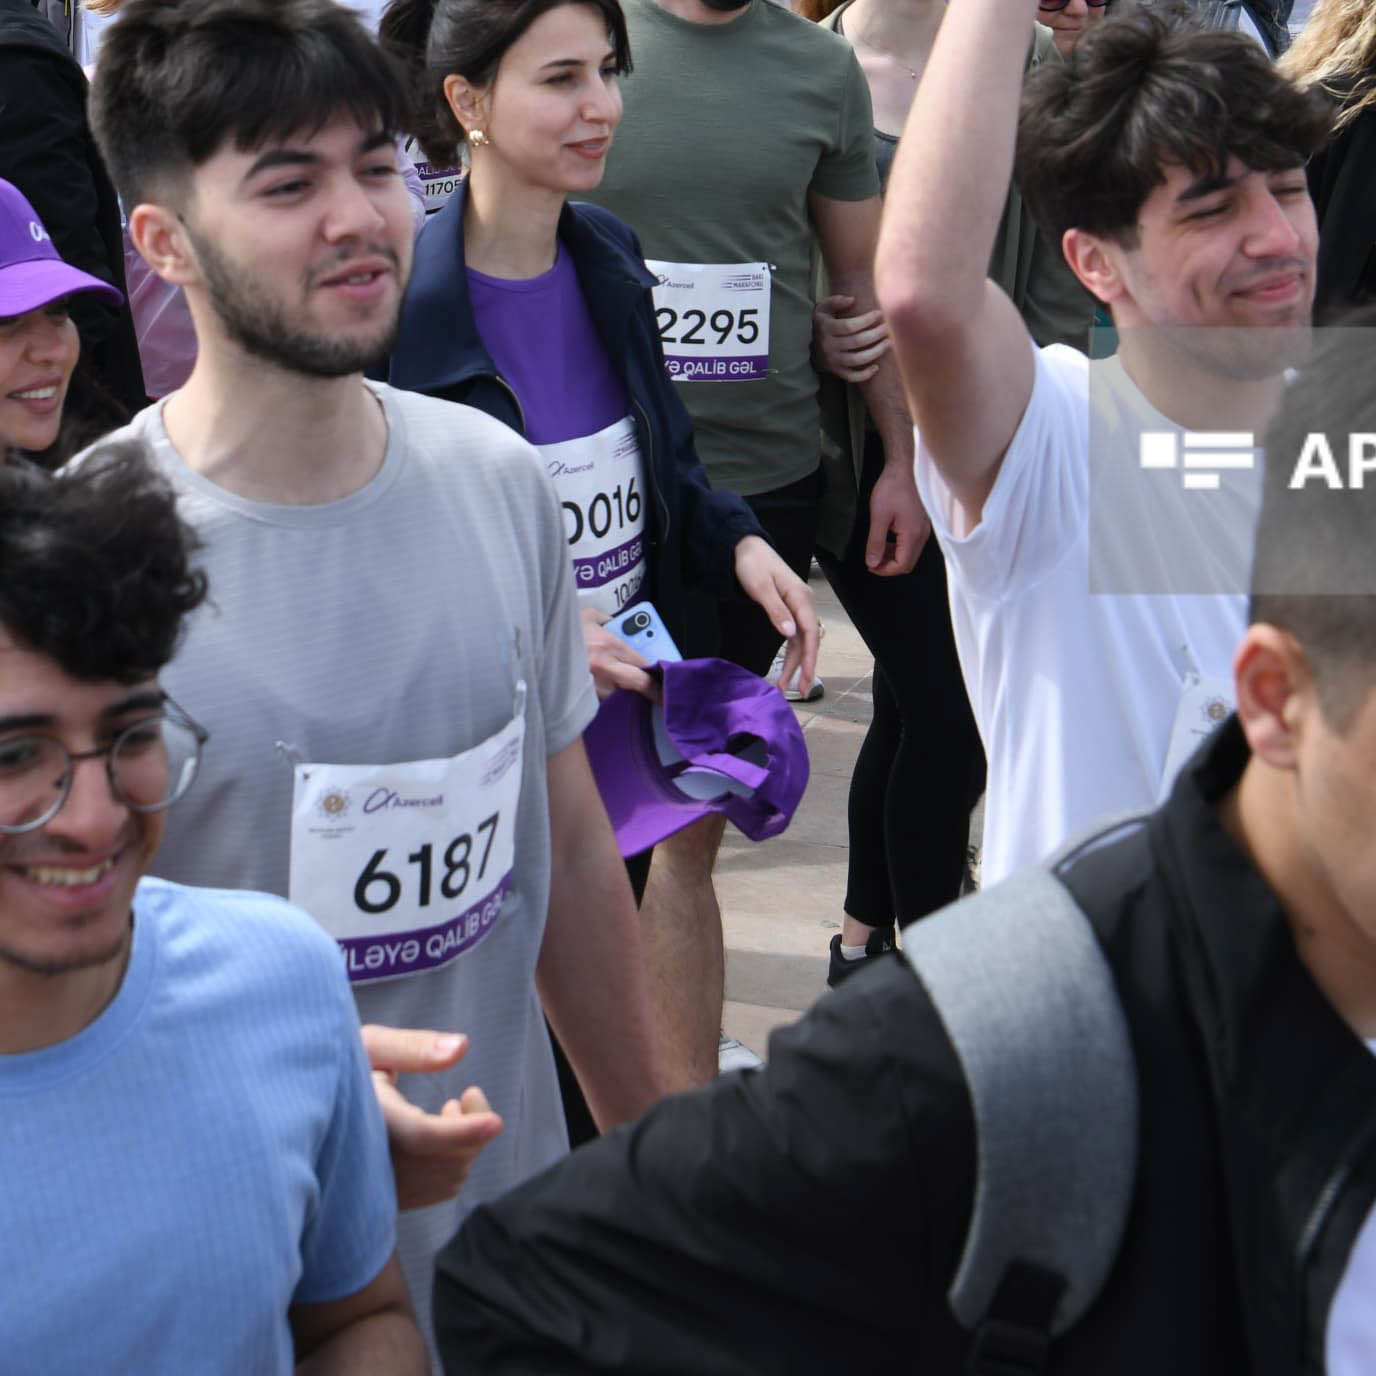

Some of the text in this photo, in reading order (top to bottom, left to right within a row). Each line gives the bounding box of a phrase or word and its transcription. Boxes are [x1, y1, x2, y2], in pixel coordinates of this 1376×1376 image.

[655, 307, 759, 345] 2295
[684, 359, 726, 375] QALİB
[729, 361, 757, 374] GƏL
[353, 810, 500, 914] 6187
[344, 939, 420, 971] LƏYƏ
[426, 913, 480, 958] QALİB
